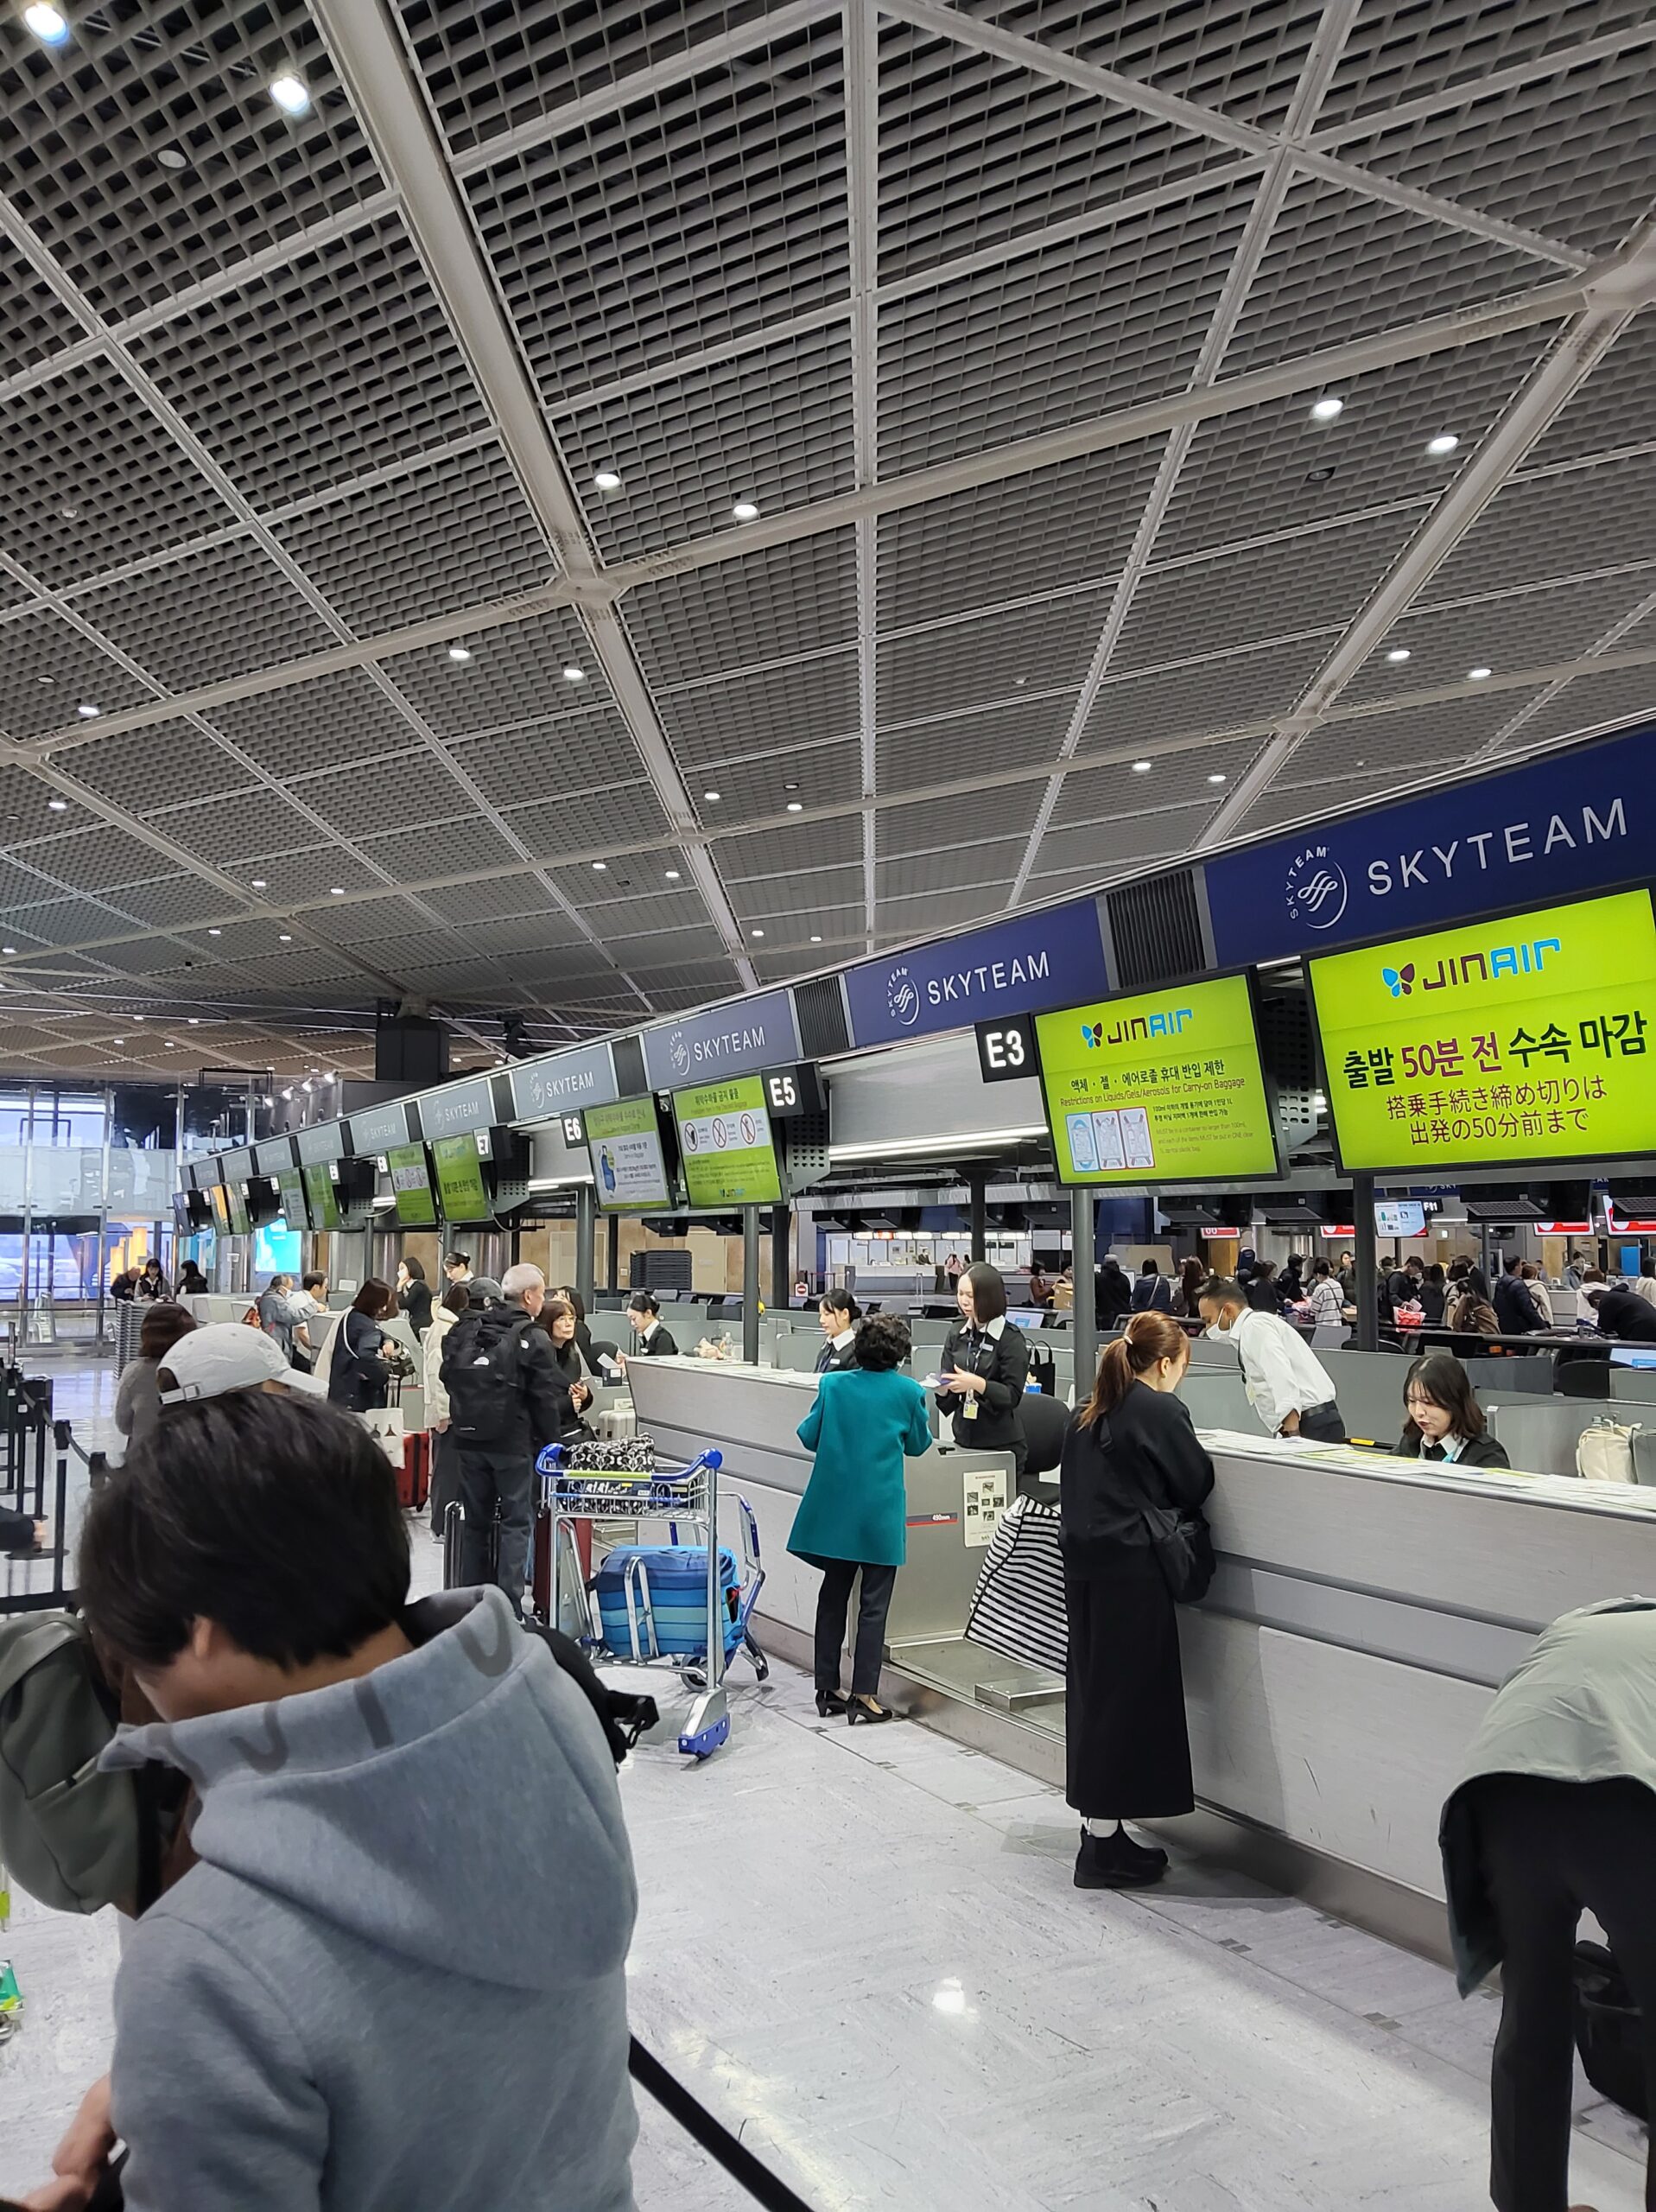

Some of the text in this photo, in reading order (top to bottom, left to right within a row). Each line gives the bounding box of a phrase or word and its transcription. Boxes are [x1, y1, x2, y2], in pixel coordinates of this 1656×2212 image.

[1367, 798, 1628, 896] SKYTEAM
[1285, 845, 1328, 919] SKYTEAM
[927, 950, 1050, 1006] SKYTEAM
[694, 1026, 765, 1062] SKYTEAM
[986, 1030, 1025, 1068] E3
[1342, 1011, 1648, 1089] 출발 50분 전 수속 마감
[546, 1071, 594, 1097] SKYTEAM
[1122, 1071, 1158, 1088] 에어로졸
[1161, 1067, 1180, 1081] 휴대
[1182, 1063, 1202, 1079] 반입
[1204, 1059, 1225, 1076] 제한
[1172, 1084, 1181, 1094] for
[1183, 1081, 1213, 1094] Carry-on
[1215, 1077, 1246, 1091] Baggage
[770, 1077, 796, 1107] E5
[1386, 1075, 1608, 1121] 搭乗手続き締め切りは
[445, 1101, 479, 1122] SKYTEAM
[1410, 1110, 1590, 1146] 出発の50分前まで
[477, 1134, 489, 1155] E7
[563, 1117, 581, 1141] E6
[1423, 1201, 1438, 1211] F11
